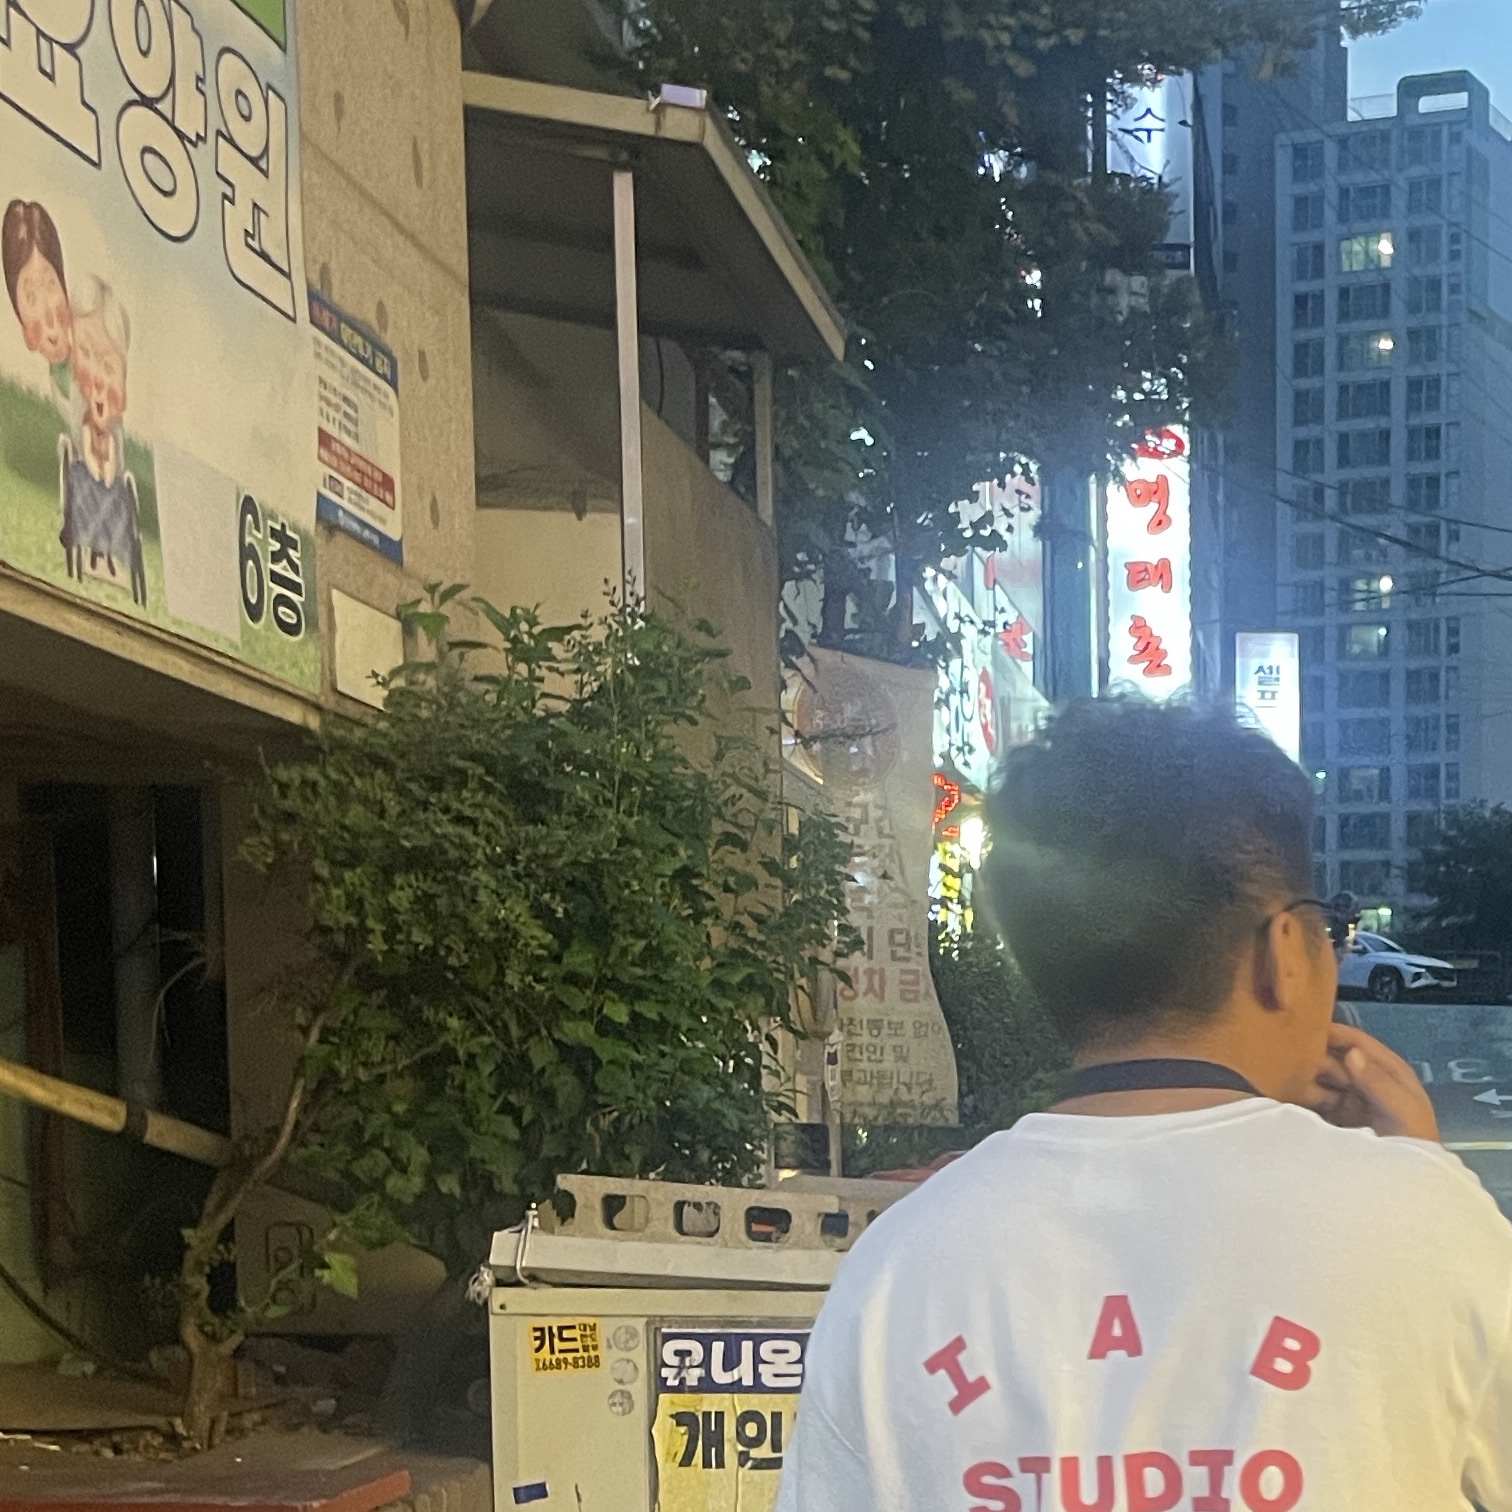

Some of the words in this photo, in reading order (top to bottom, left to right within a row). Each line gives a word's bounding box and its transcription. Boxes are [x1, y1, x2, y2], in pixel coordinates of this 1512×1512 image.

[238, 493, 304, 640] 6층
[532, 1324, 580, 1356] 카드
[661, 1339, 804, 1388] 유니온
